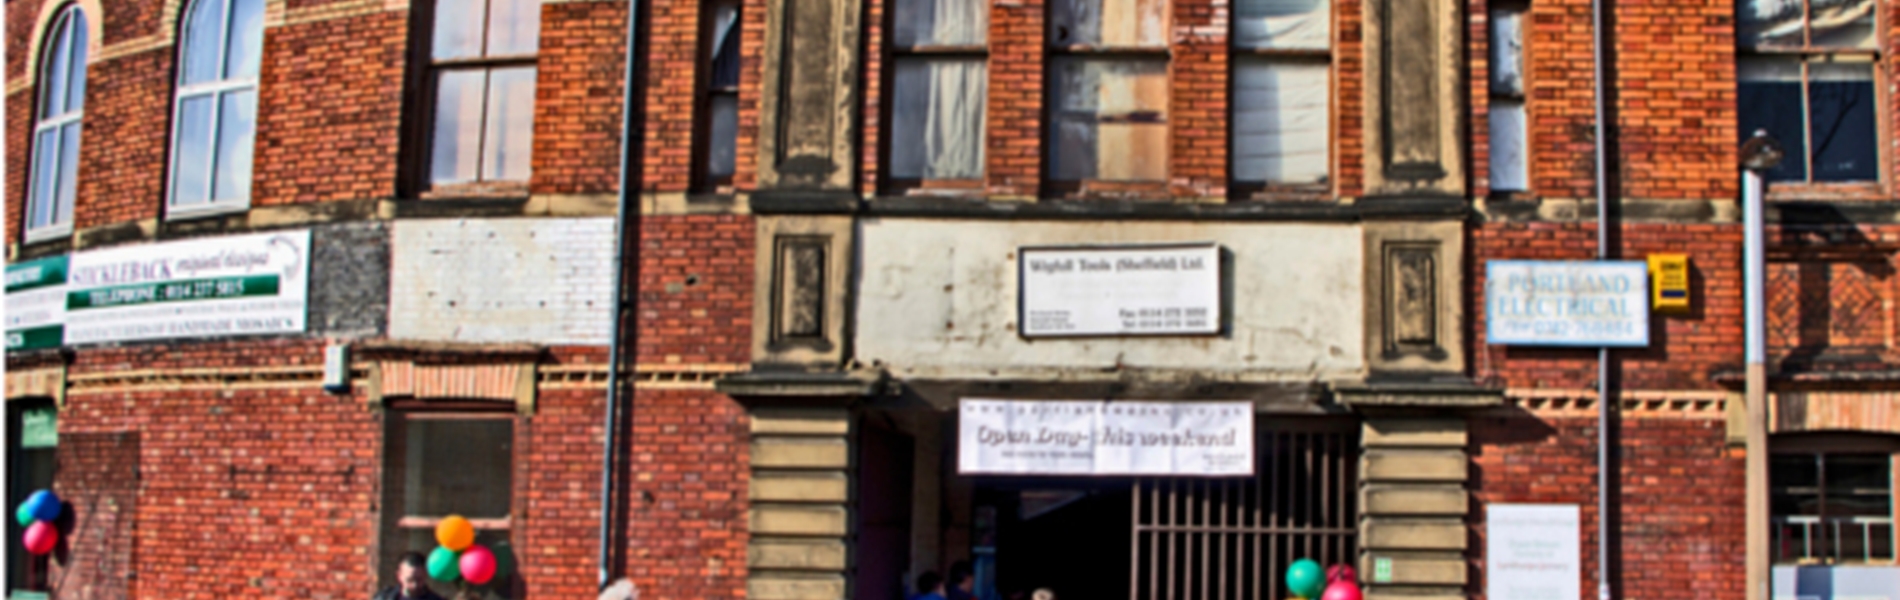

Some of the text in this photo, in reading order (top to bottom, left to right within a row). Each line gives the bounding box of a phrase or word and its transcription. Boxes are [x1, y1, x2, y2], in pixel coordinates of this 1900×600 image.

[73, 257, 171, 284] STICKLEBACK
[90, 284, 156, 305] TELEPHONE
[1507, 273, 1631, 295] PORTLAND
[1498, 296, 1634, 318] ELECTRICAL
[977, 425, 1030, 447] Open
[1140, 428, 1236, 447] weekend
